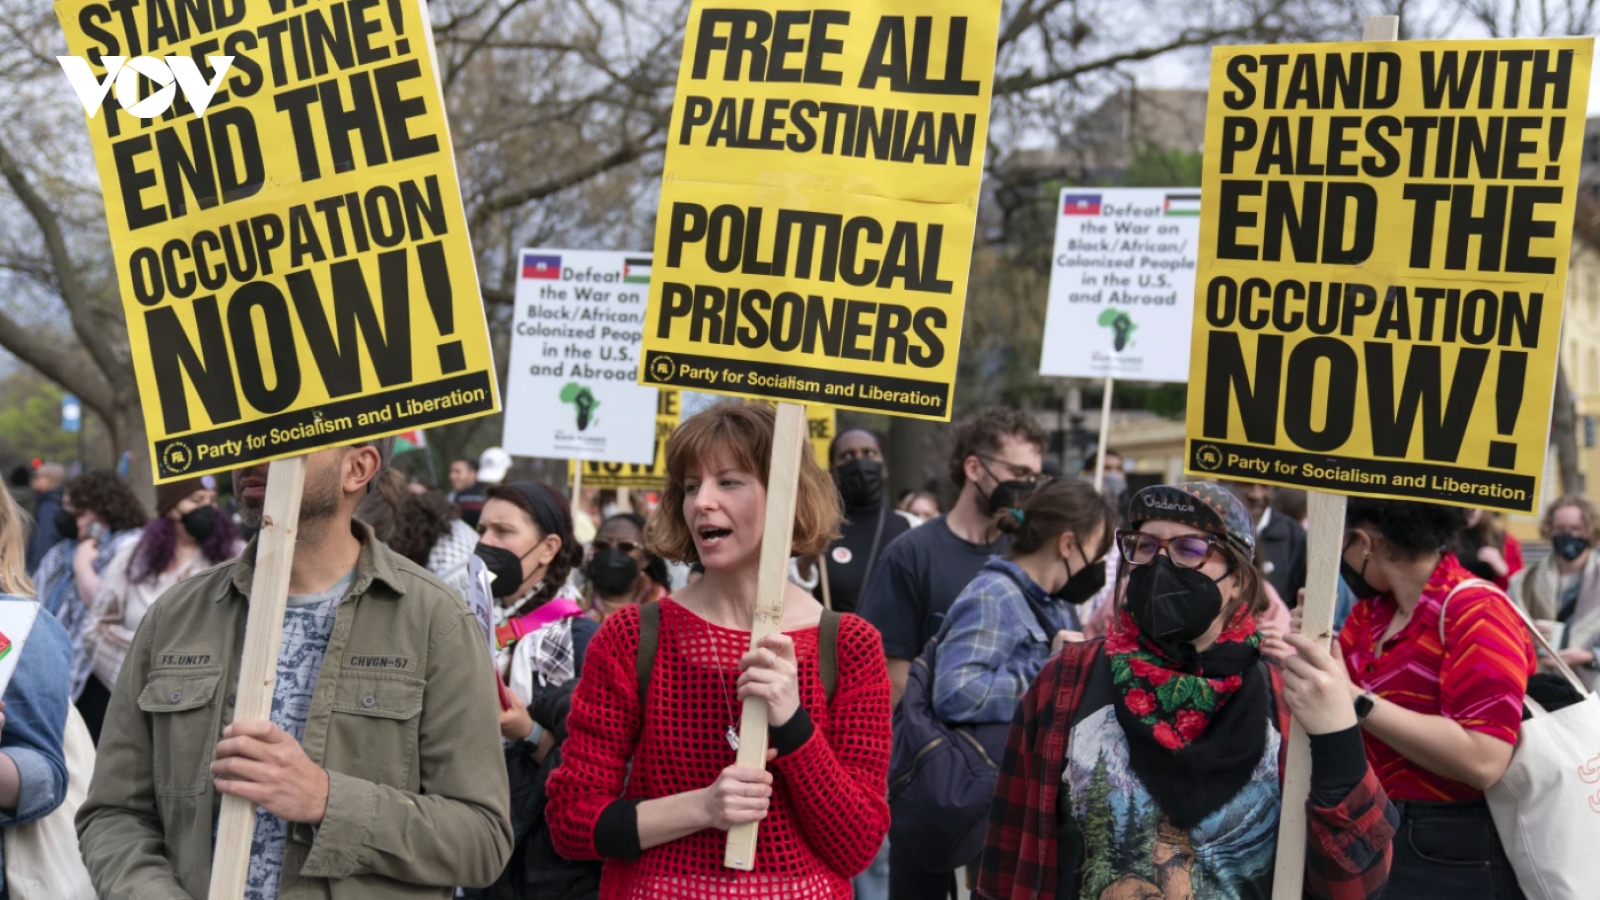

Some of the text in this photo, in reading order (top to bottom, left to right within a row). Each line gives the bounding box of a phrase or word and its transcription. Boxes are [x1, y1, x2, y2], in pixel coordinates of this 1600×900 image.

[97, 0, 412, 138] ESTINE!
[691, 8, 981, 96] FREE ALL
[1223, 49, 1575, 111] STAND WITH
[112, 59, 440, 231] END THE
[679, 95, 977, 166] PALESTINIAN
[1219, 115, 1567, 181] PALESTINE!
[1080, 220, 1179, 235] the War on
[1103, 203, 1160, 217] Defeat
[1216, 179, 1565, 275] END THE
[130, 175, 448, 306] OCCUPATION
[666, 201, 954, 295] POLITICAL
[1068, 238, 1188, 253] Black/African/
[562, 267, 620, 283] Defeat
[1057, 254, 1195, 273] Colonized People
[1082, 272, 1172, 288] in the U.S.
[540, 285, 640, 303] the War on
[1069, 290, 1177, 305] and Abroad
[1205, 275, 1545, 349] OCCUPATION
[144, 241, 467, 435] NOW!
[516, 322, 643, 344] Colonized Peop
[656, 281, 948, 369] PRISONERS
[530, 362, 563, 376] and
[570, 364, 638, 381] Abroad
[542, 342, 633, 361] in the U.S.
[679, 363, 718, 384] Party
[722, 368, 744, 384] for
[747, 371, 820, 393] Socialism
[824, 383, 854, 398] and
[858, 384, 941, 407] Liberation
[1202, 330, 1529, 470] NOW!
[196, 440, 242, 461] Party
[246, 434, 267, 450] for
[270, 416, 353, 444] Socialism
[358, 406, 392, 427] and
[396, 388, 485, 418] Liberation
[1227, 454, 1270, 473] Party
[1274, 459, 1298, 475] for
[1302, 463, 1387, 485] Socialism
[1392, 475, 1427, 488] and
[1432, 475, 1526, 501] Liberation
[1143, 494, 1195, 513] Cadence
[162, 654, 211, 666] FS.UNLTD
[350, 656, 408, 668] CHVGN-57
